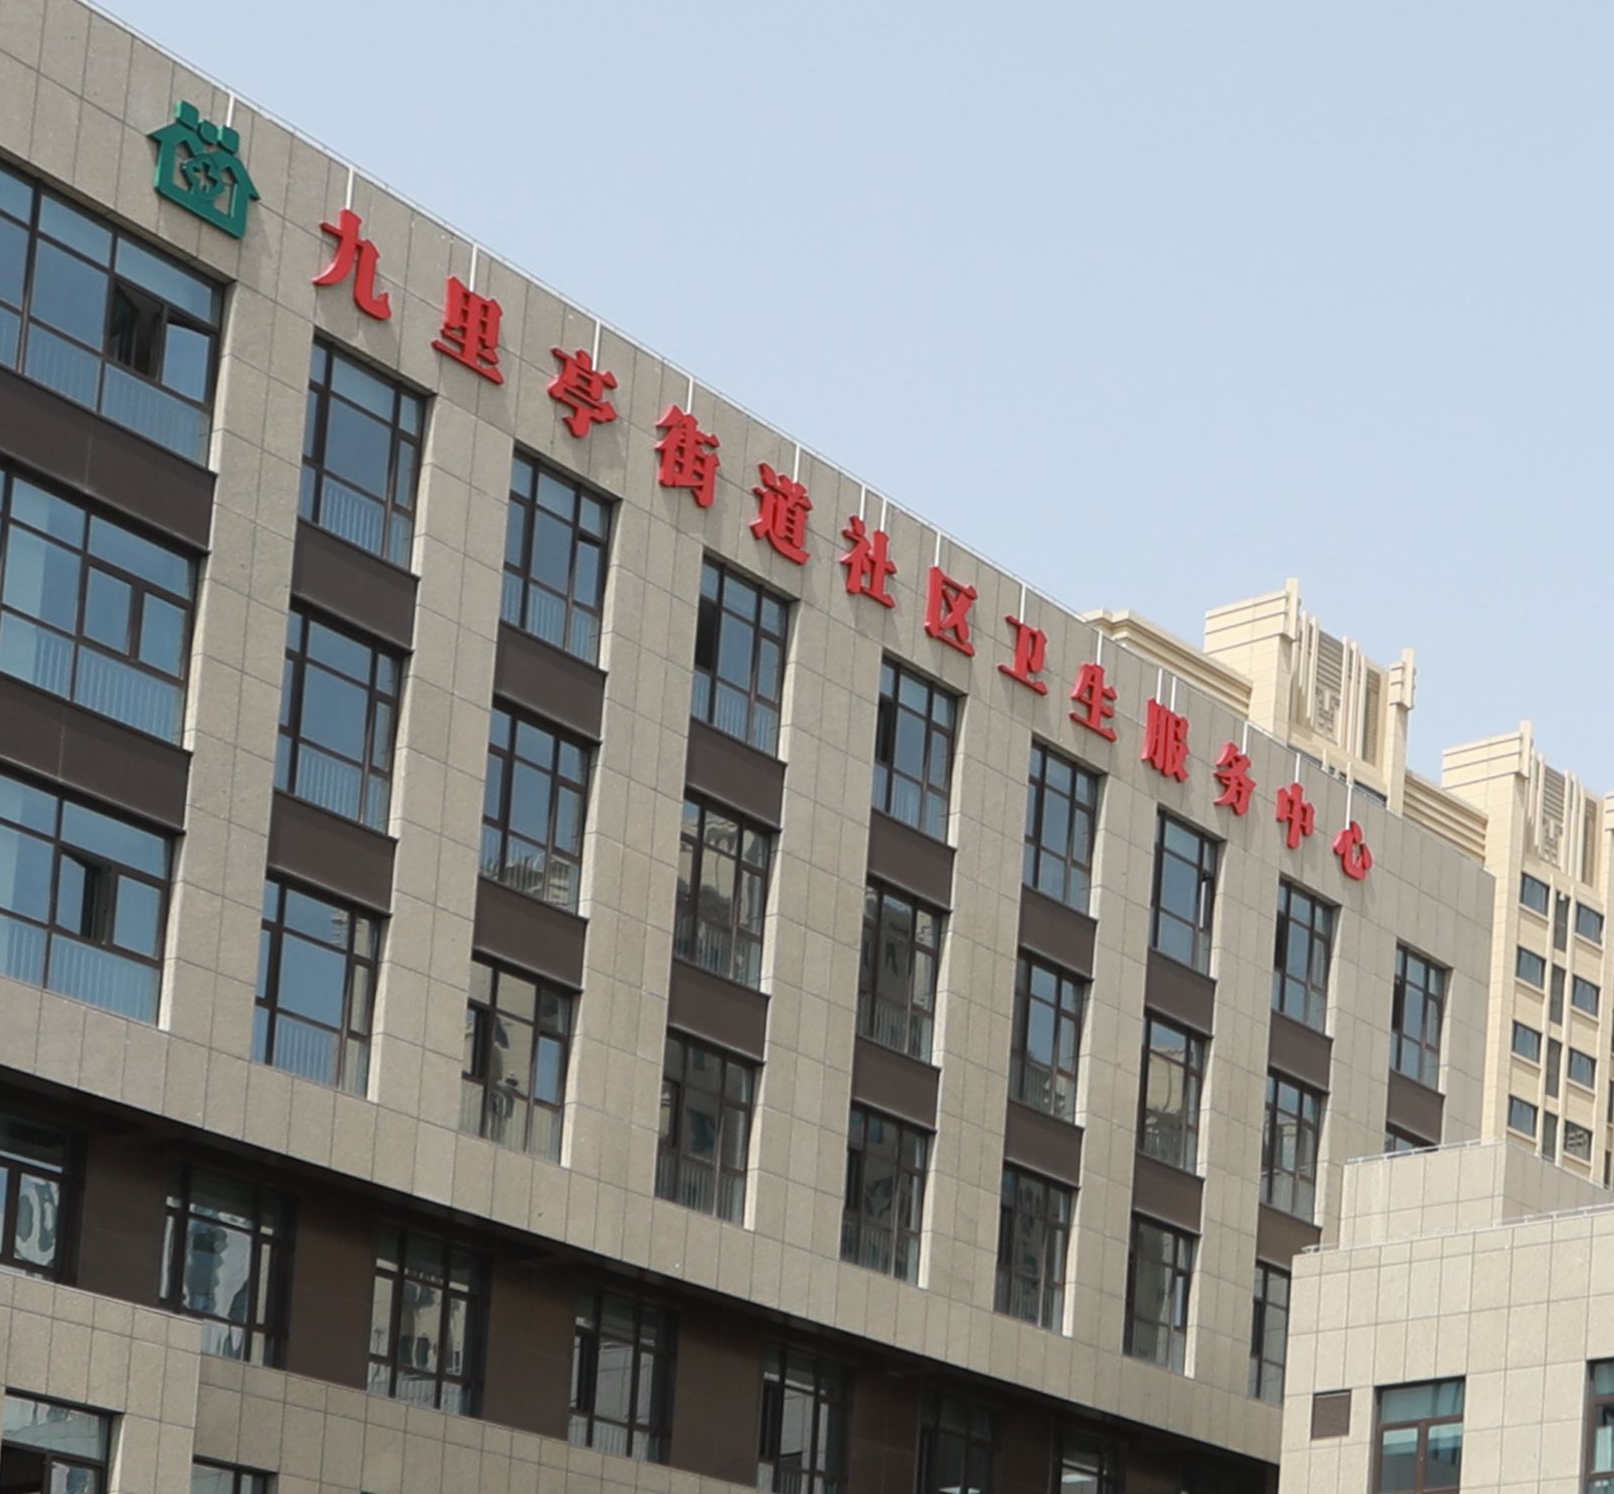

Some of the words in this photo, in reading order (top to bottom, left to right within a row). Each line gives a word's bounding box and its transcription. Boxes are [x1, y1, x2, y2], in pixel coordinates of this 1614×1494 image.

[312, 208, 1373, 881] 九里亭街道社区卫生服务中心
